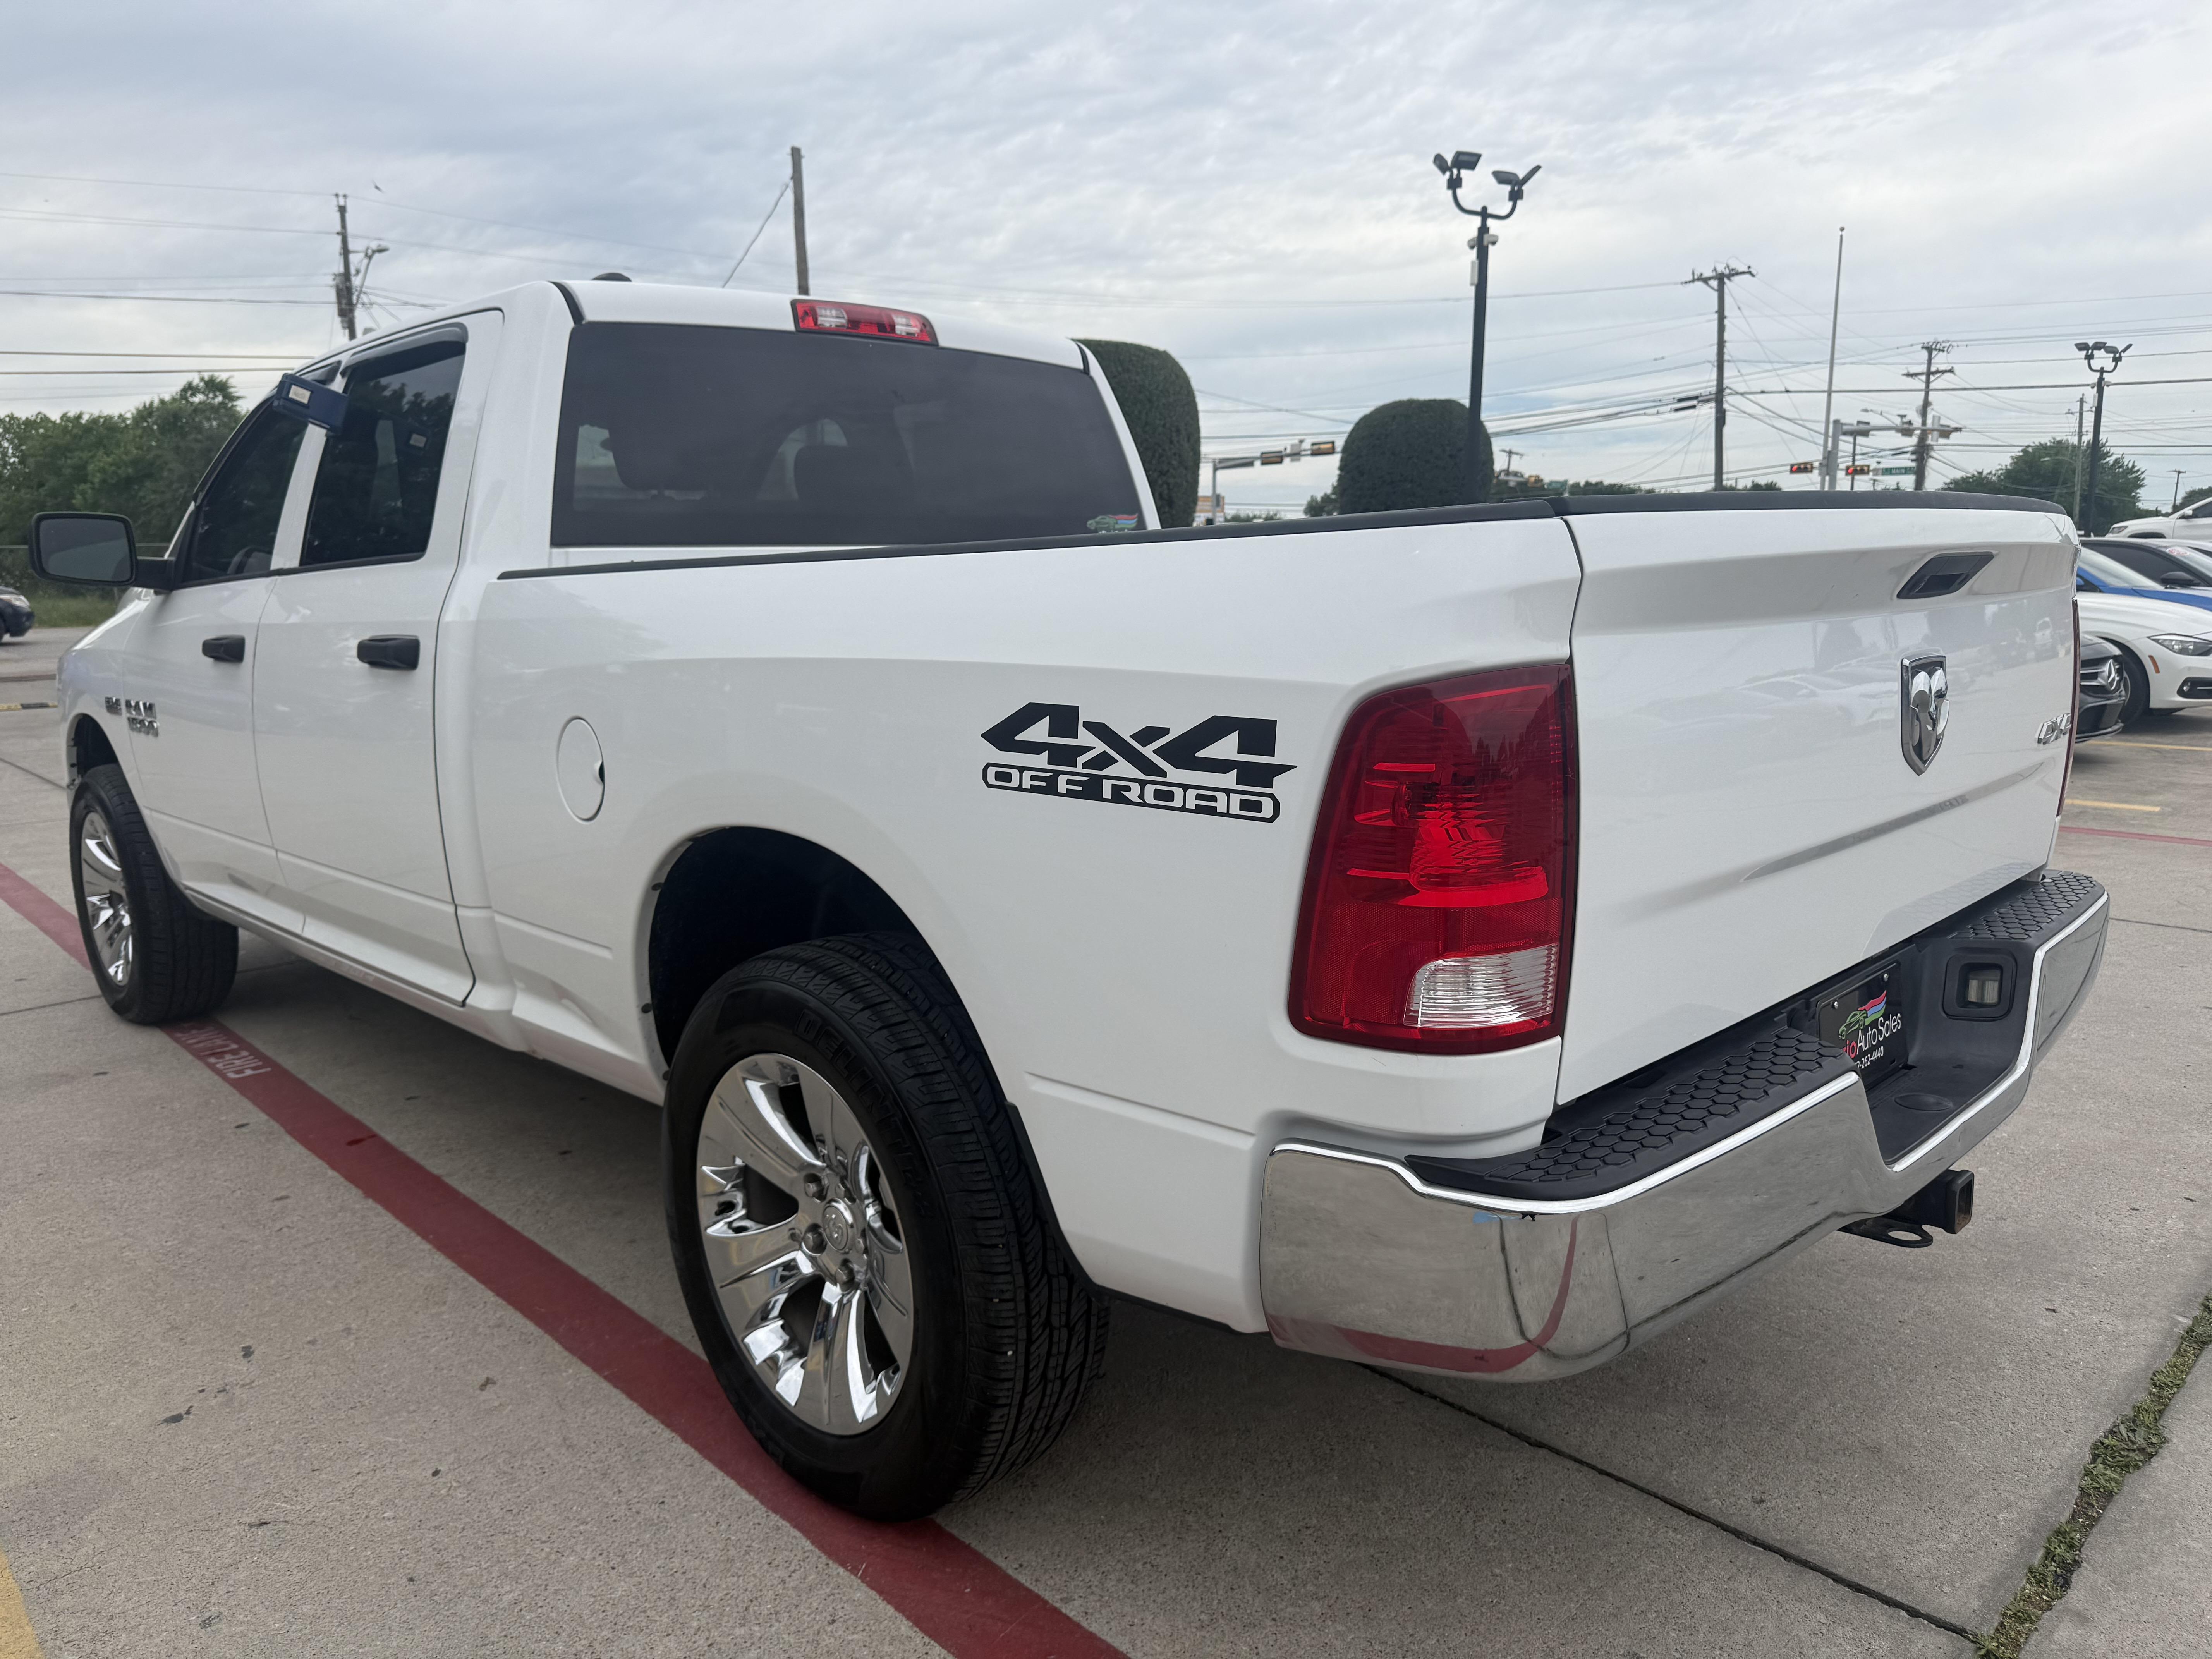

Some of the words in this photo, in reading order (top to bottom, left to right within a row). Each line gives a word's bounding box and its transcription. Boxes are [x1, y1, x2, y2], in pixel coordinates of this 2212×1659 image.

[987, 766, 1091, 794] OFF
[1102, 778, 1273, 819] ROAD
[207, 1050, 272, 1079] FIRE
